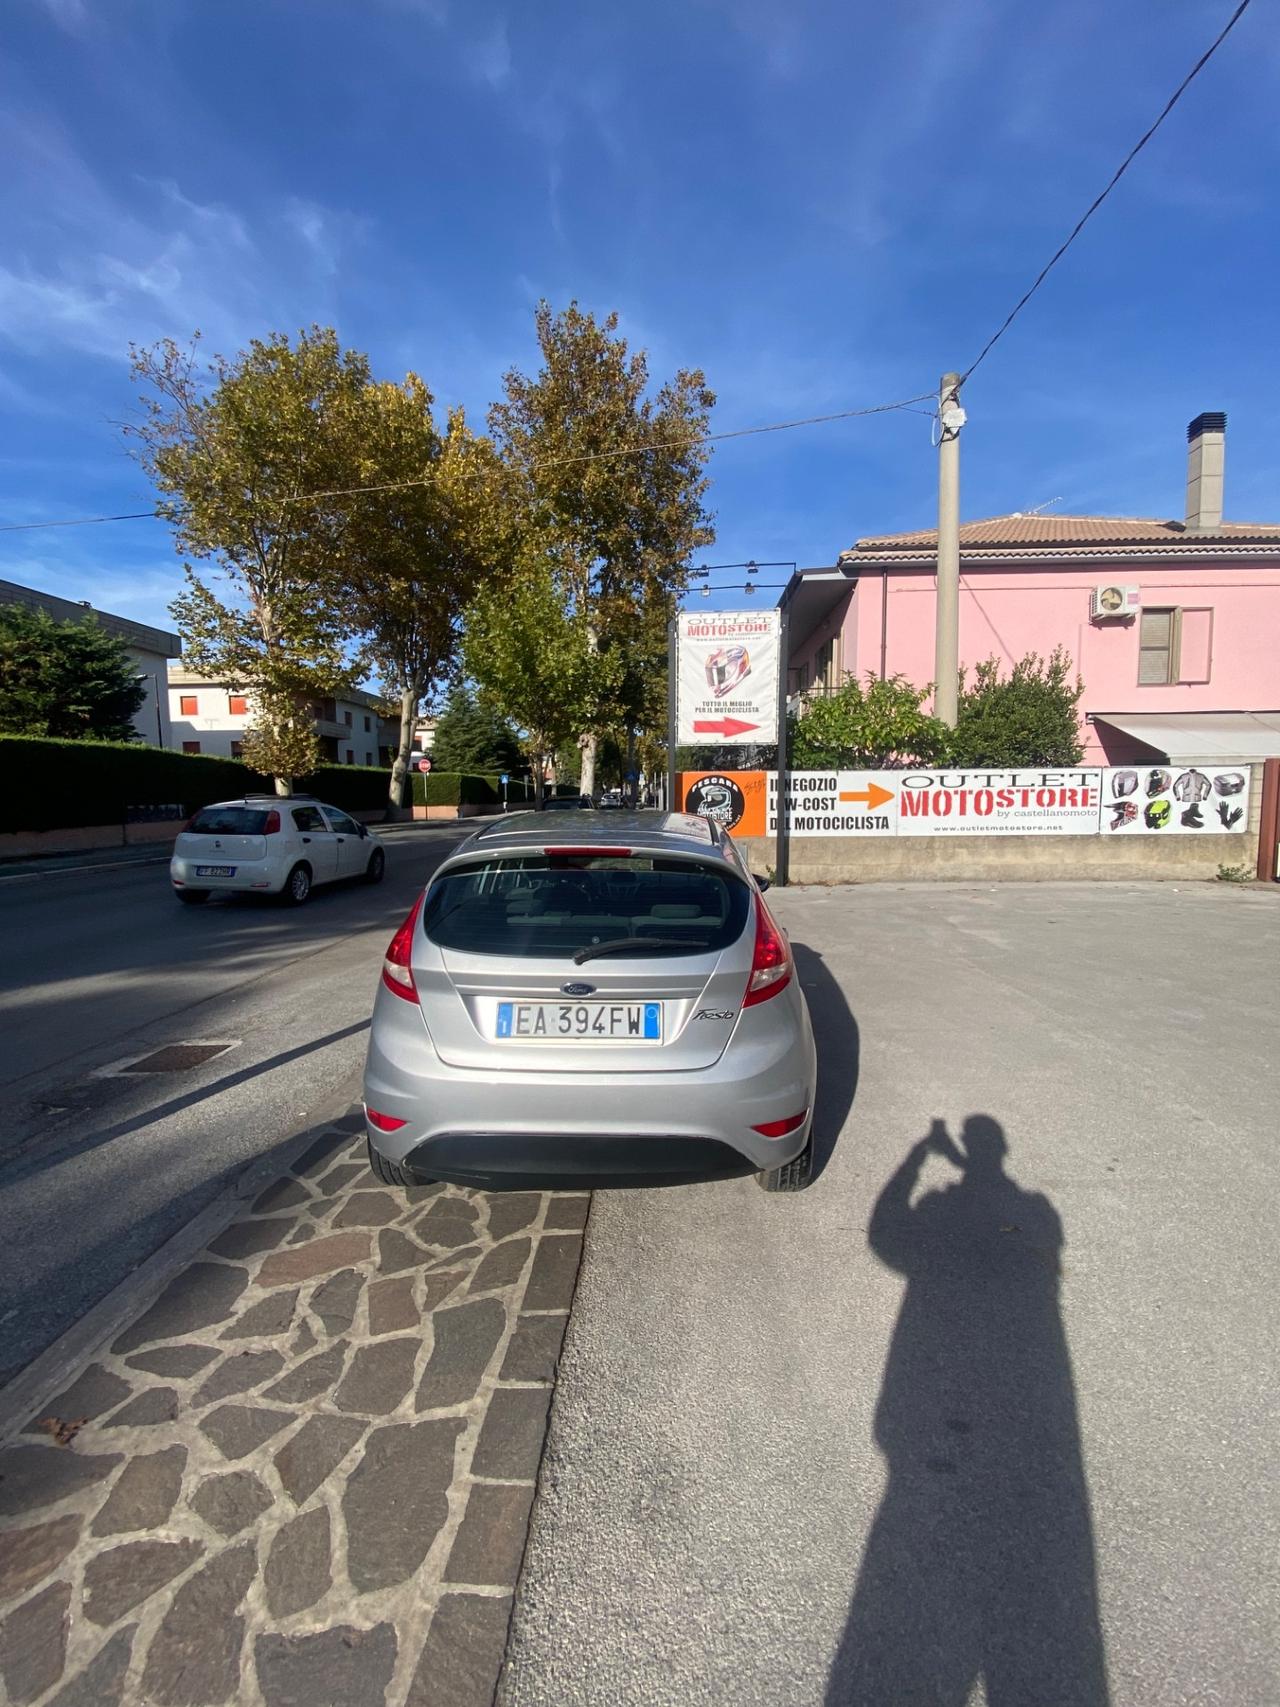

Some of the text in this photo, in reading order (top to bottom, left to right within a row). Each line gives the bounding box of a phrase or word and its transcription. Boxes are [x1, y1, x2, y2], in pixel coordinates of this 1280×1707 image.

[688, 617, 772, 625] OUTLET
[688, 624, 771, 636] MOTOSTORE
[692, 777, 738, 792] PESCARA
[784, 777, 837, 791] NEGOZIO
[901, 773, 1099, 788] OUTLET
[770, 797, 837, 811] LW-COST
[900, 788, 1098, 817] MOTOSTORE
[997, 808, 1098, 819] by castellanomoto
[770, 816, 890, 830] DL MOTOCICLISTA
